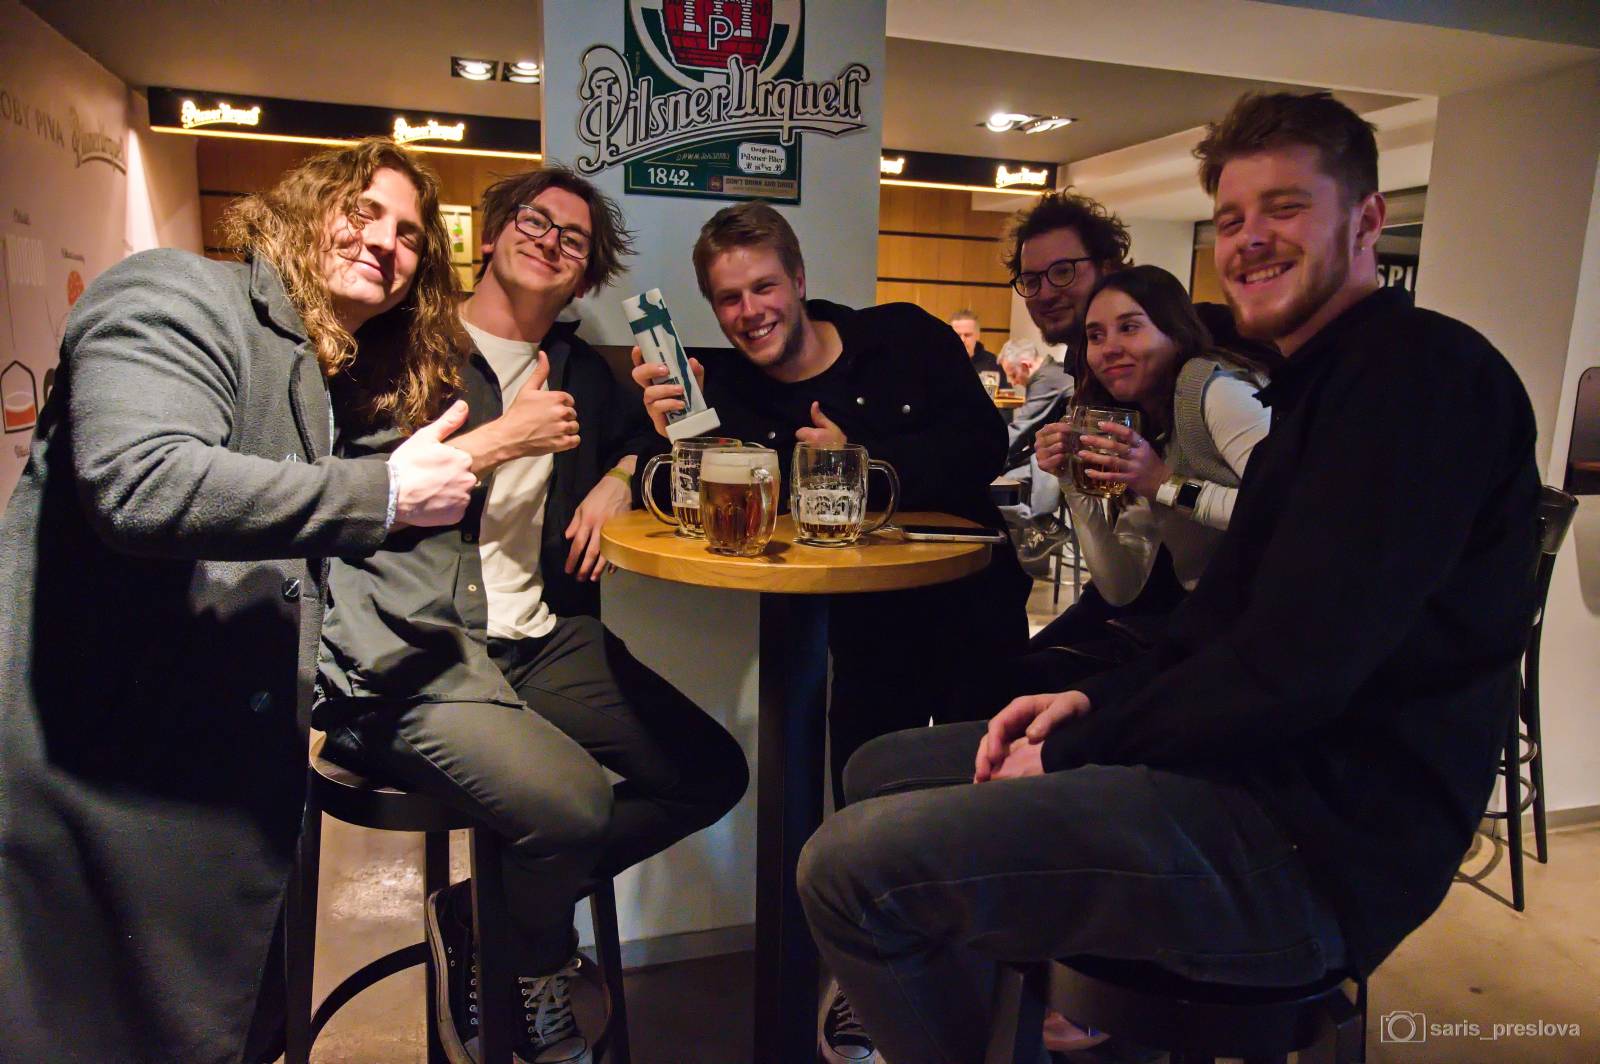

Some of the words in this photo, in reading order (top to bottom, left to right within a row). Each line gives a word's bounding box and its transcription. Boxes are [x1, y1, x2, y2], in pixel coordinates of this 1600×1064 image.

[576, 44, 731, 175] Pilsner
[728, 54, 871, 146] Urquell
[36, 108, 65, 148] PIVA
[740, 153, 768, 162] Pilsner
[768, 155, 785, 163] Bier
[750, 147, 777, 155] Original
[1376, 264, 1414, 292] SPI
